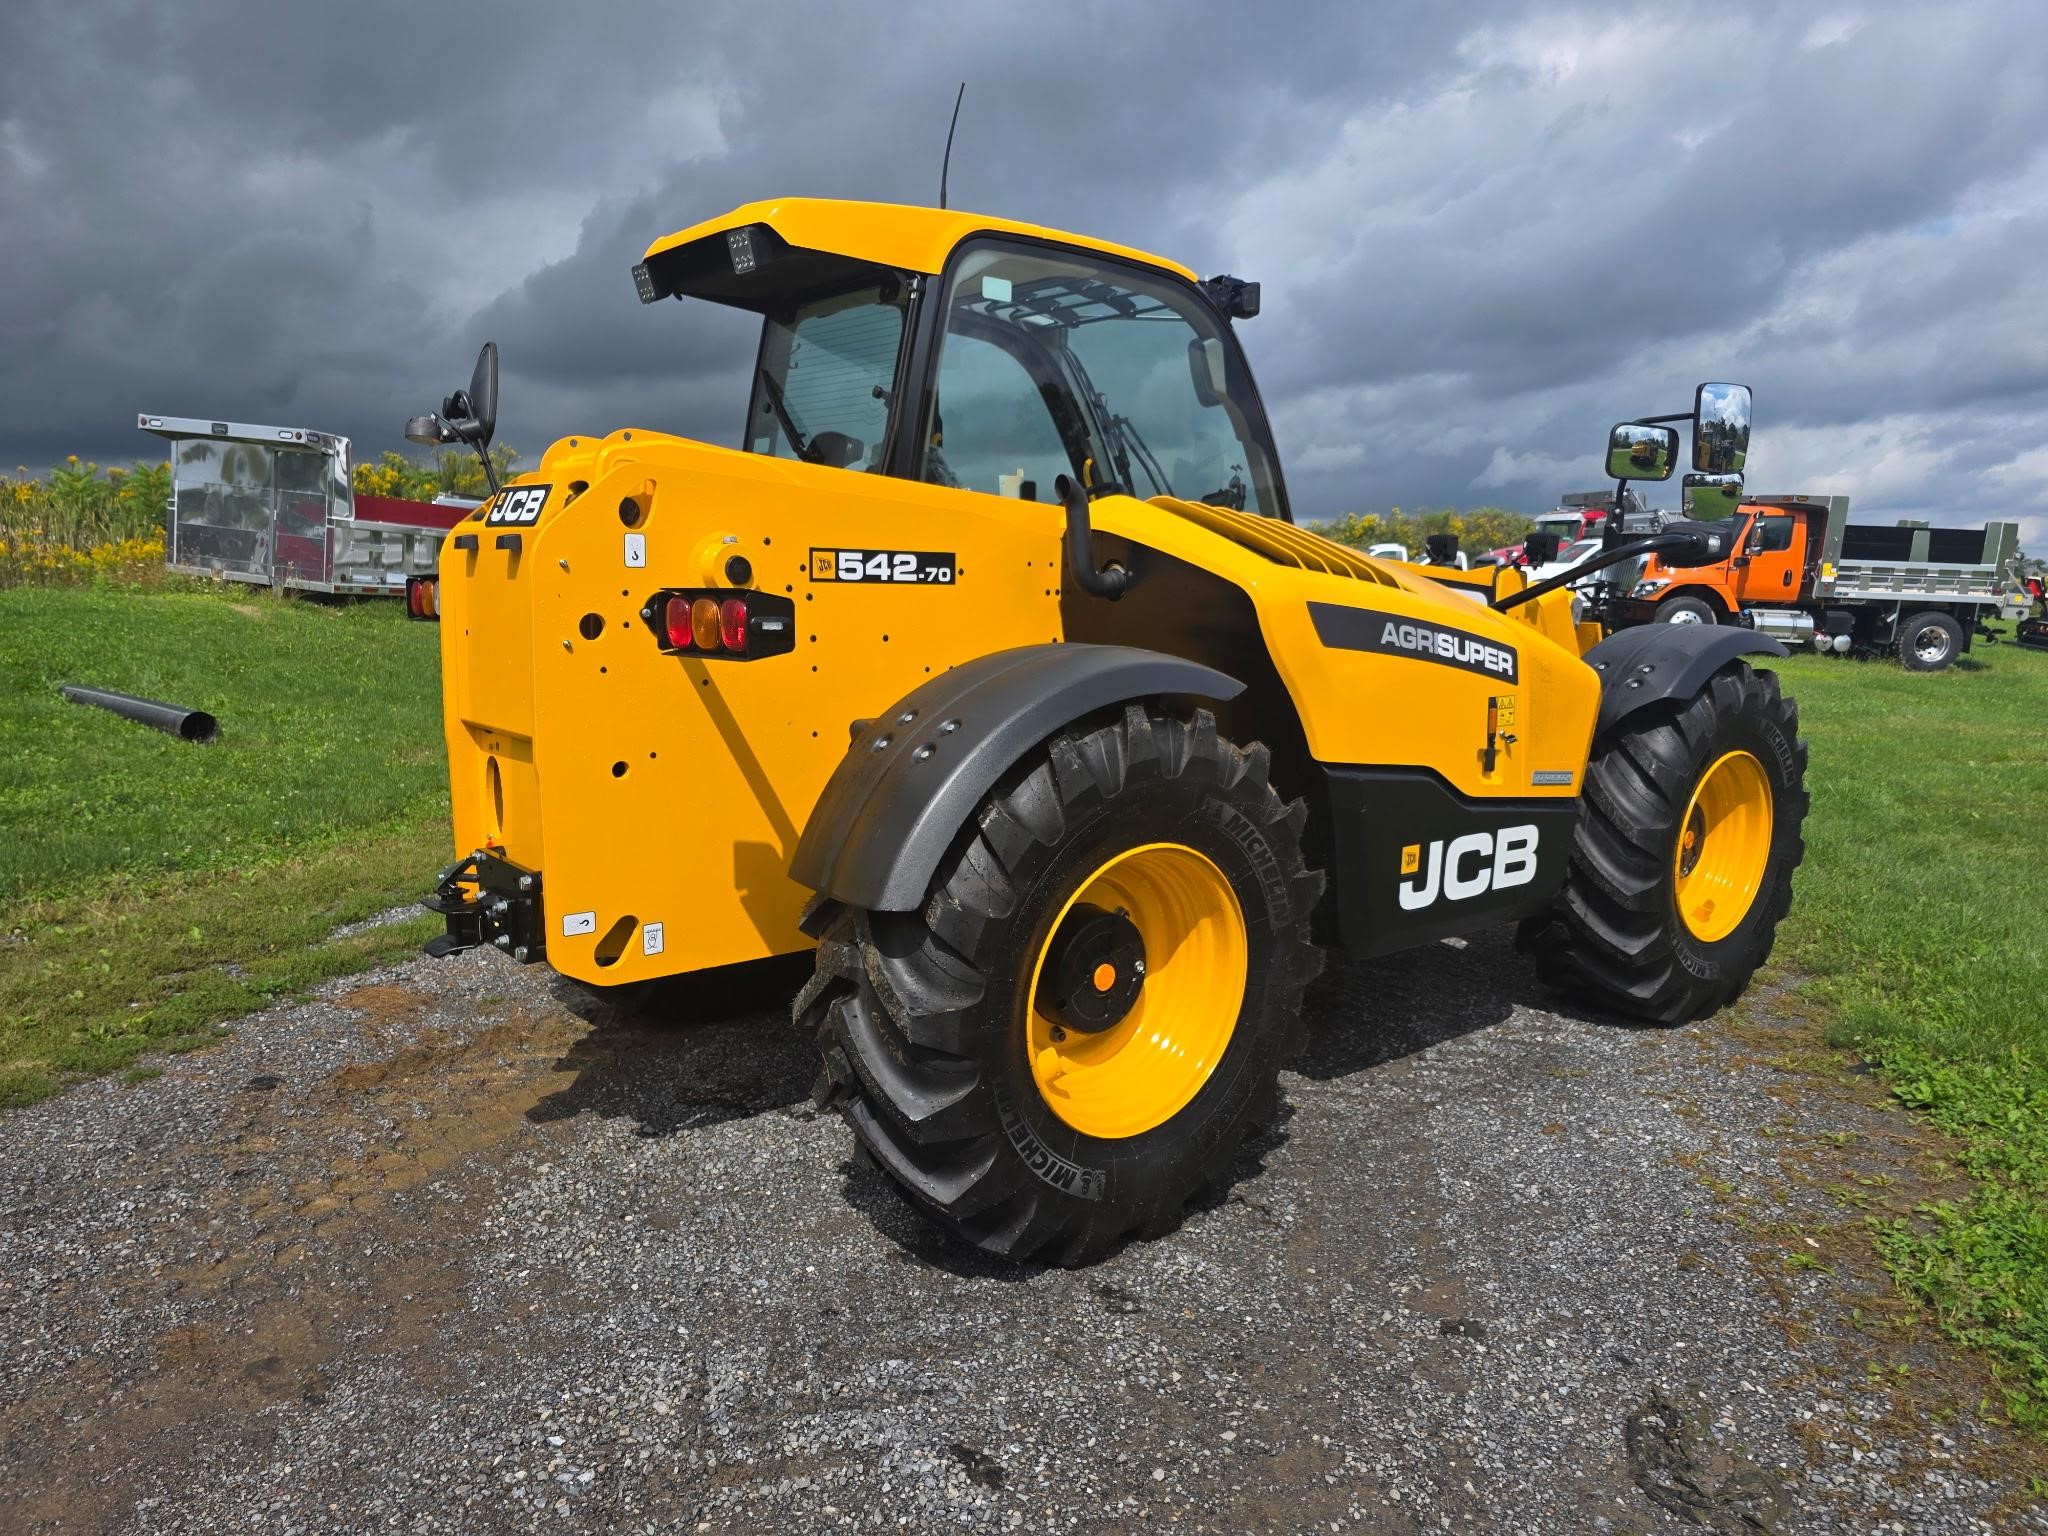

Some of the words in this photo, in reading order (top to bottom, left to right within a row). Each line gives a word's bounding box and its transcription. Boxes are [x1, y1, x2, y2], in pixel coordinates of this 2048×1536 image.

[490, 489, 546, 522] JCB
[815, 557, 833, 573] JCB
[1380, 621, 1513, 676] AGRISUPER
[1223, 812, 1291, 927] MICHELIN
[1399, 824, 1539, 911] JCB
